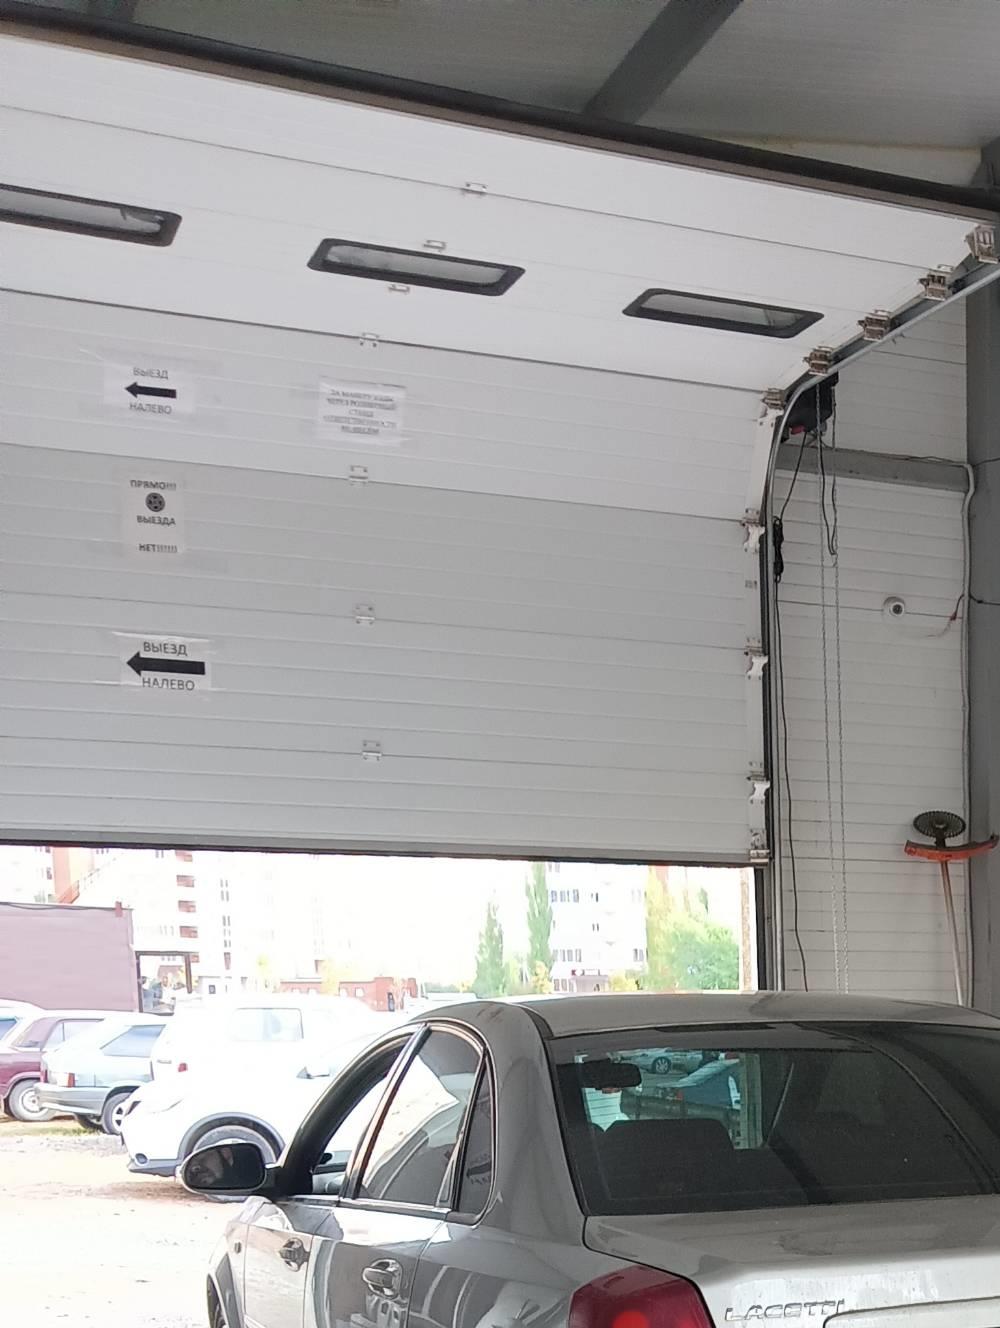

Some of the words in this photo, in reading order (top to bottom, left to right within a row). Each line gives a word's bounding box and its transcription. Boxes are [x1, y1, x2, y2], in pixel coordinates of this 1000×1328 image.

[133, 367, 169, 380] ВЫЕЗД
[129, 402, 172, 415] НАЛЕВО
[136, 515, 177, 527] ВЫЕЗДА
[143, 641, 188, 657] ВЫЕЗД
[142, 677, 196, 692] НАЛЕВО
[725, 1299, 845, 1322] LACETTI
